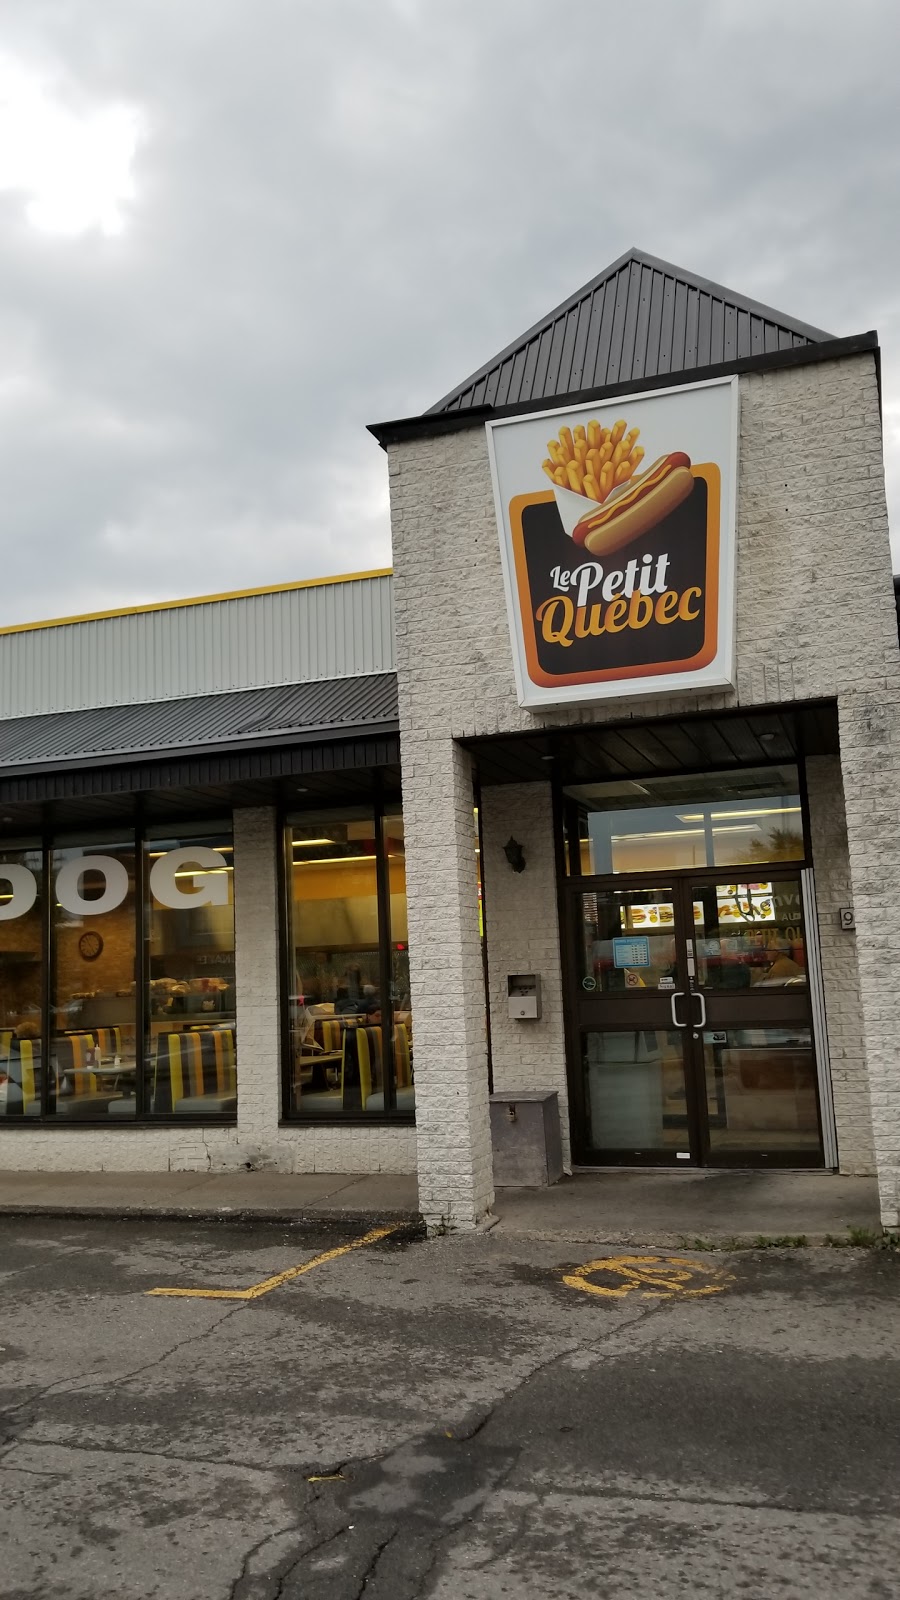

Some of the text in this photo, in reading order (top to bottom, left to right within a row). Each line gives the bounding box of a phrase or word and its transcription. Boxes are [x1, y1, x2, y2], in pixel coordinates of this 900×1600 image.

[550, 553, 671, 608] Le Petit
[535, 586, 702, 648] Québec
